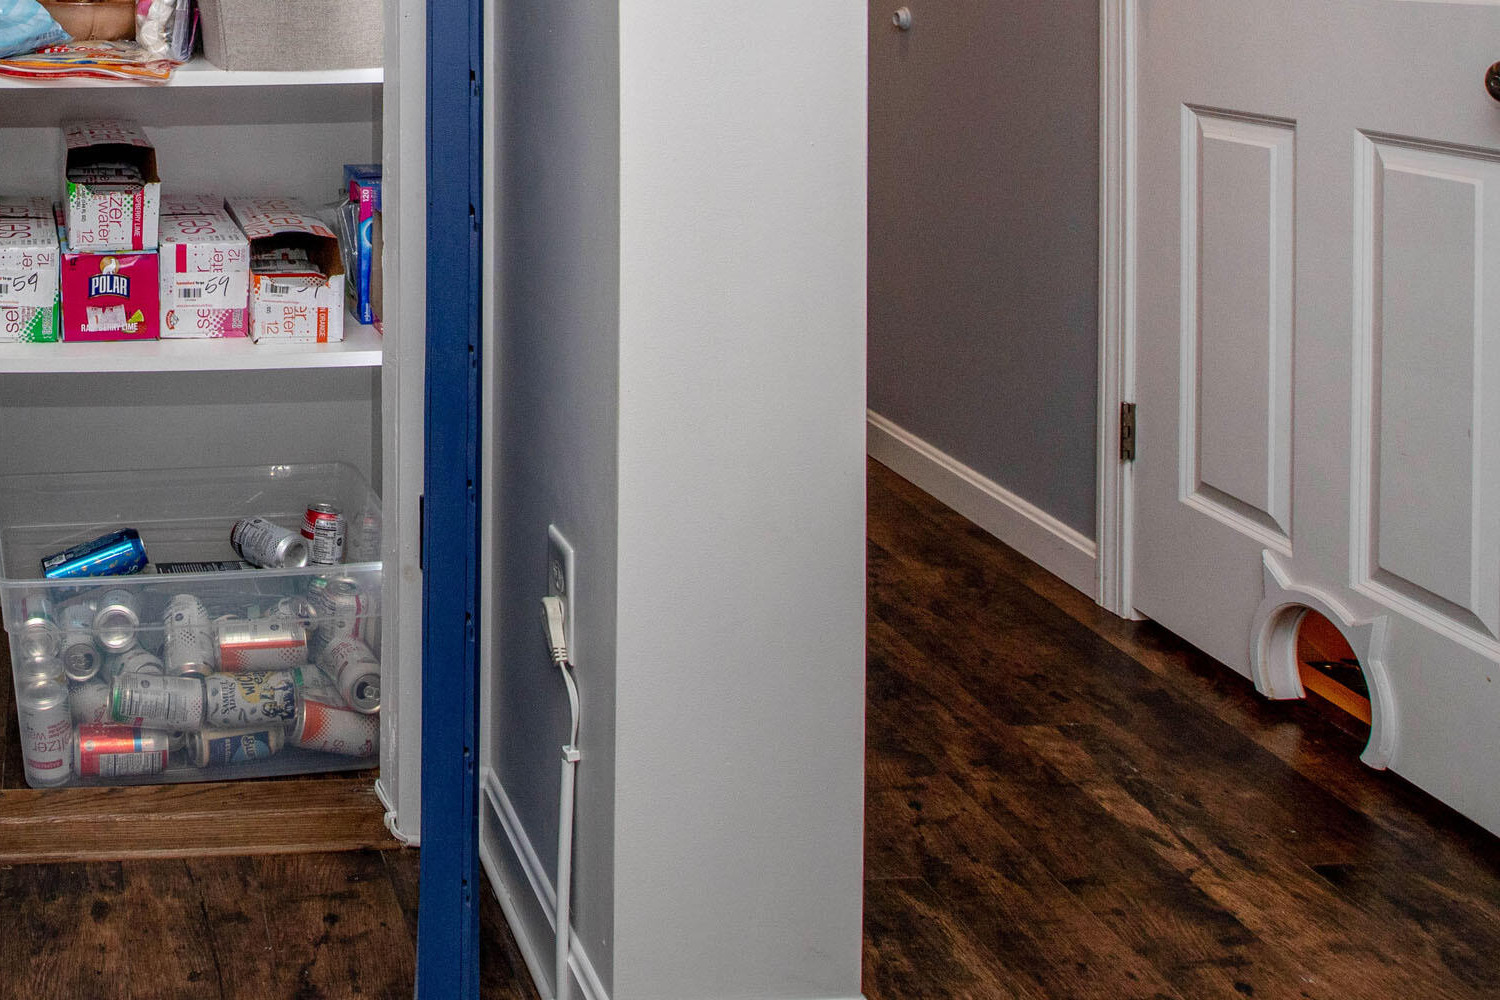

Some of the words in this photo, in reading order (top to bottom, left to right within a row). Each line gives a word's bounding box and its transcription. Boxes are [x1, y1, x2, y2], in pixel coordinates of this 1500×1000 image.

[362, 188, 370, 203] 120
[98, 201, 109, 243] water
[82, 229, 94, 243] 12
[37, 253, 50, 266] 12
[228, 249, 241, 263] 12
[91, 275, 128, 295] POLAR
[267, 320, 280, 334] 12
[219, 679, 230, 715] SAMUEL
[228, 682, 238, 711] ADAMS
